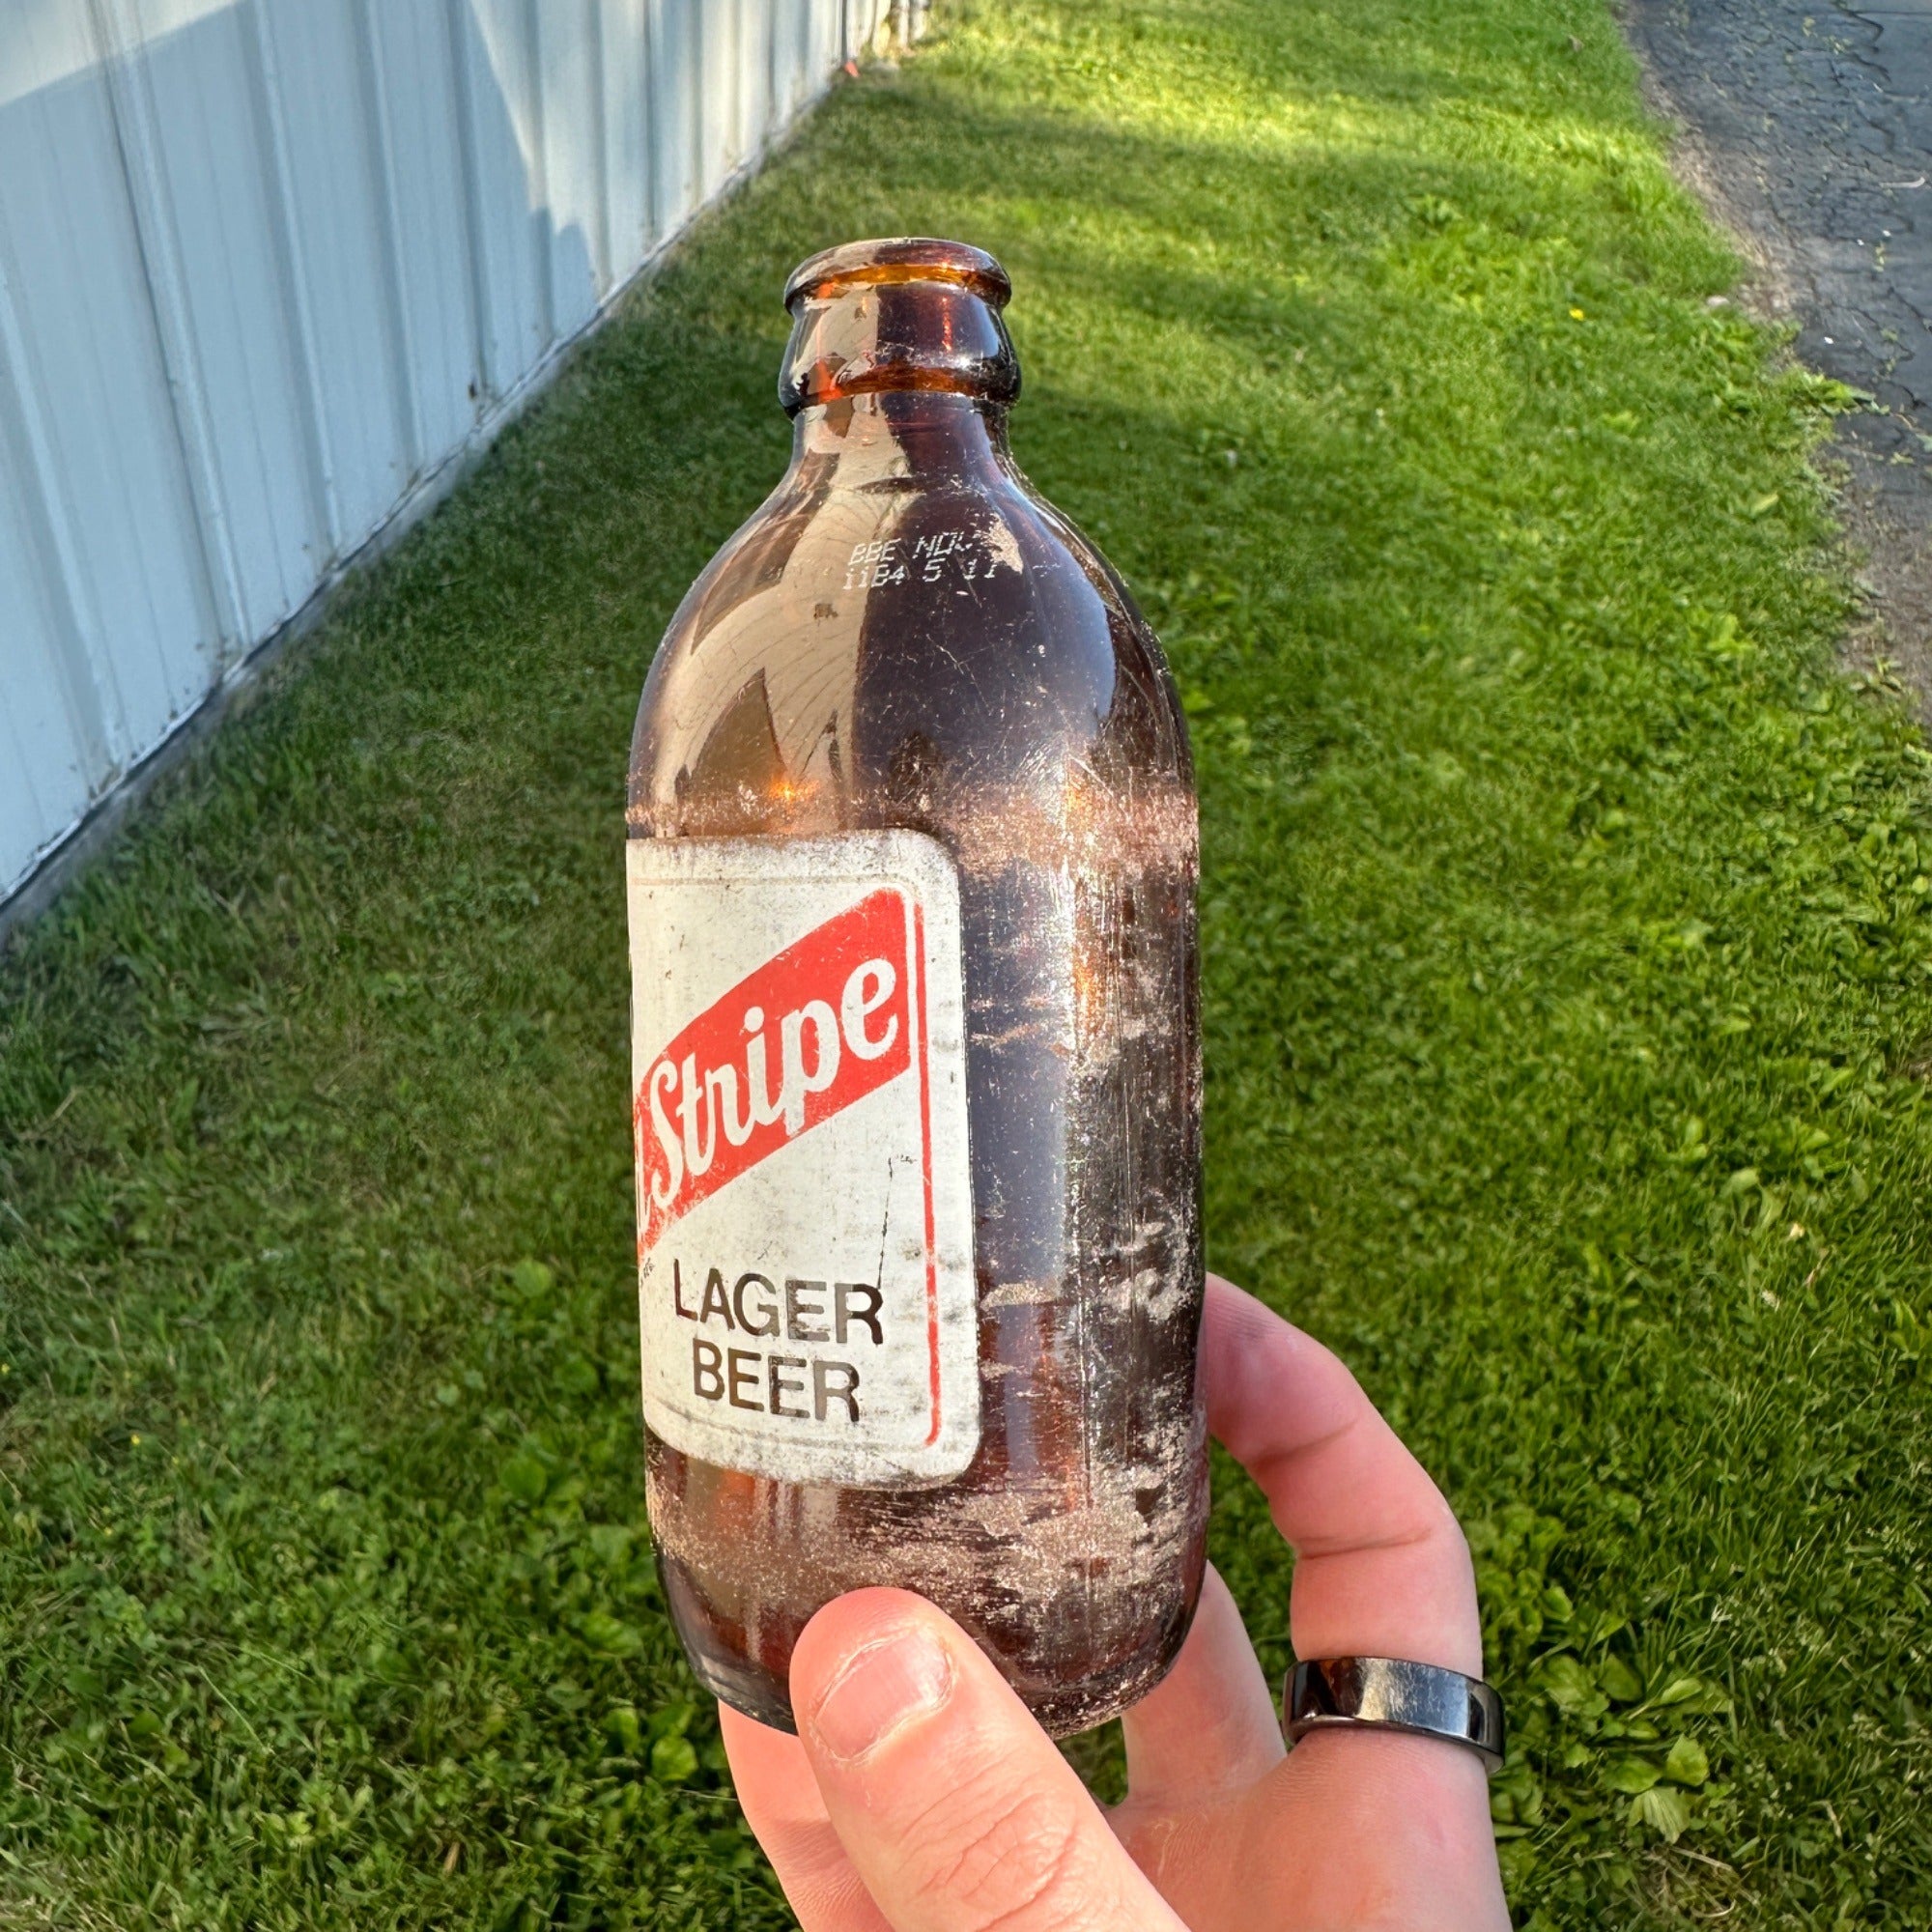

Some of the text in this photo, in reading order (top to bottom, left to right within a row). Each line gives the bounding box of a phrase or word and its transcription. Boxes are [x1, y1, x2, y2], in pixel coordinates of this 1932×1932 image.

[922, 557, 947, 582] 5
[649, 957, 899, 1208] Stripe
[673, 1257, 885, 1346] LAGER
[692, 1337, 861, 1423] BEER
